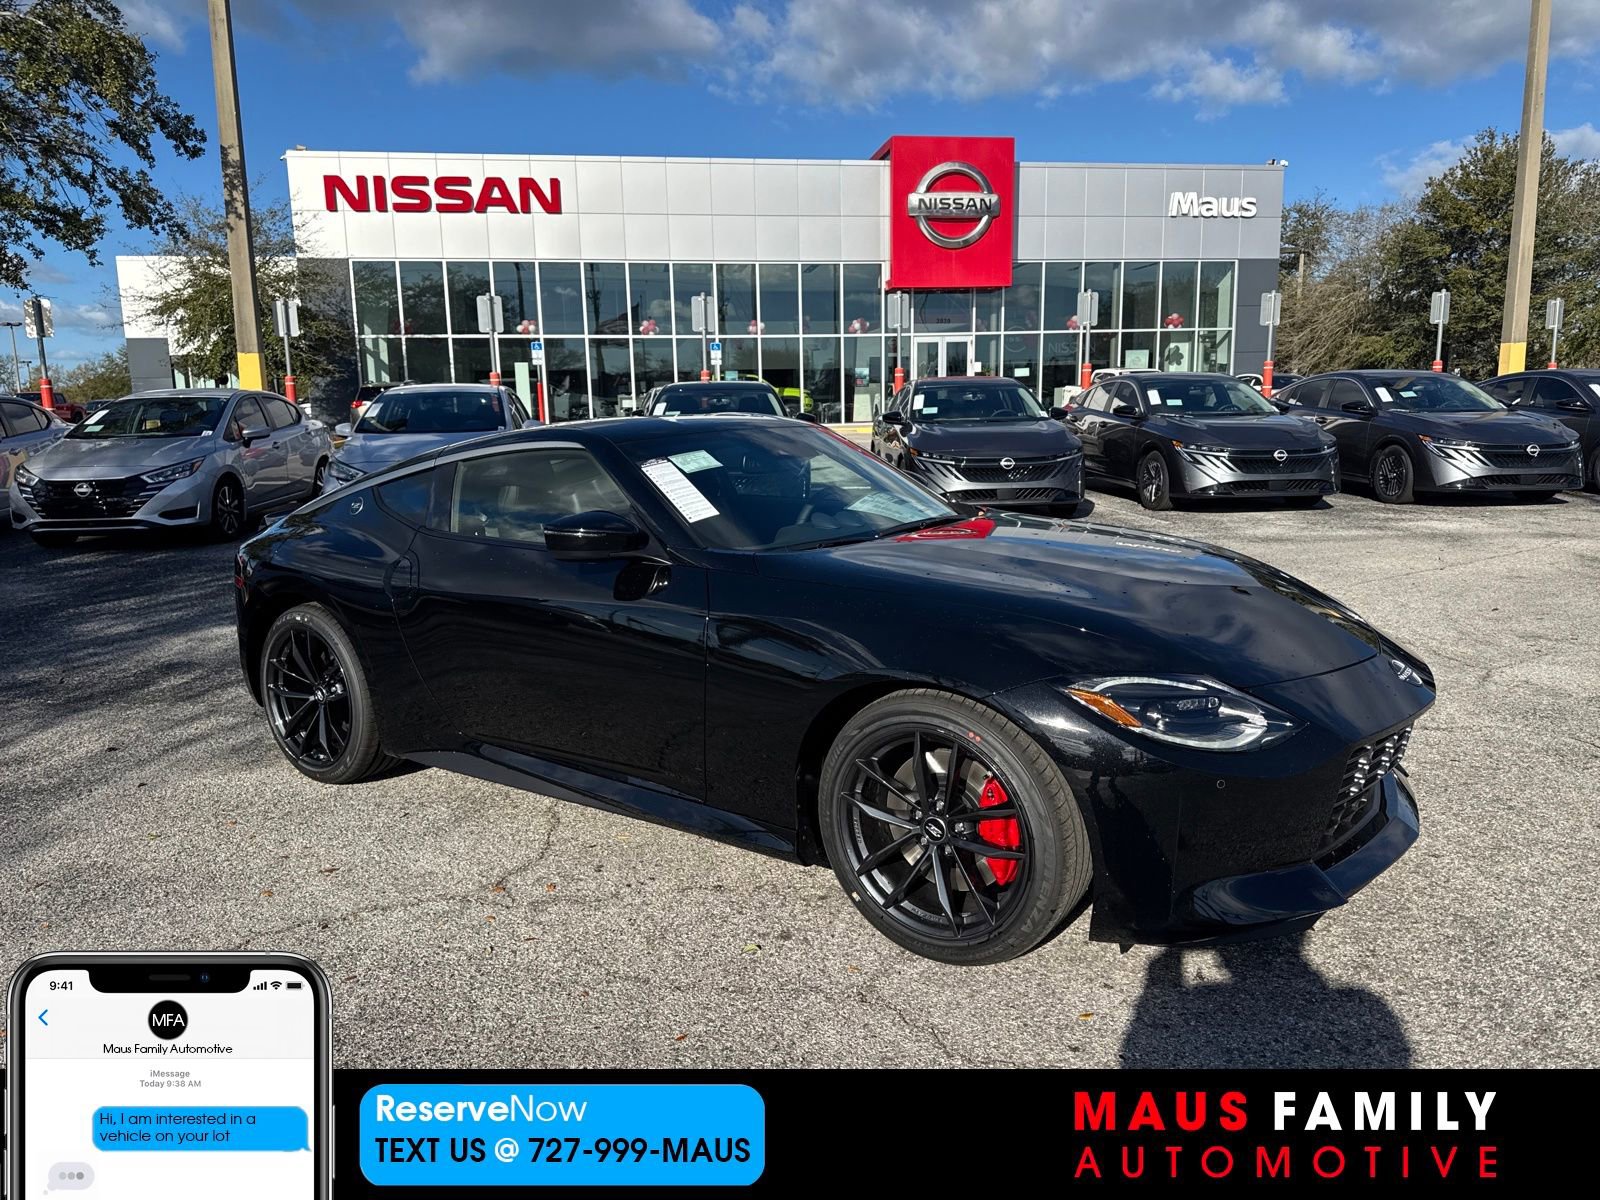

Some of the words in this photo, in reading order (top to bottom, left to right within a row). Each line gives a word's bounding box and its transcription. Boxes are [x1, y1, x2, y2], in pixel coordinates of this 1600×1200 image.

[323, 174, 562, 212] NISSAN
[917, 196, 993, 212] NISSAN
[1168, 191, 1258, 219] Maus
